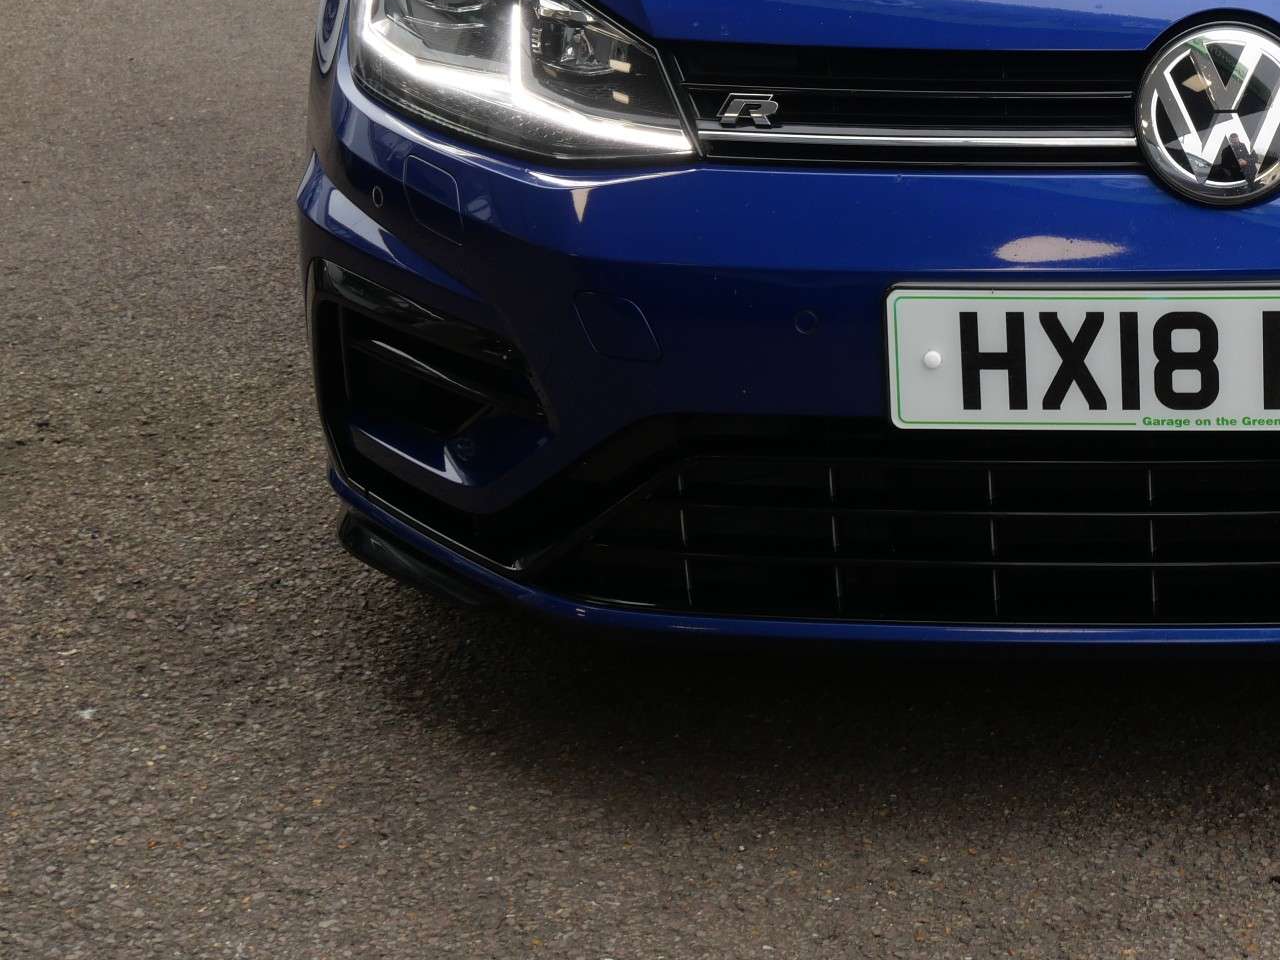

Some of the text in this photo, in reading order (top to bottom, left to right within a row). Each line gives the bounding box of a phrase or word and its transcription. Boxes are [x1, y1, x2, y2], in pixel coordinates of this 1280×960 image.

[716, 92, 779, 127] R
[958, 310, 1221, 411] HX18
[1142, 416, 1190, 428] Garage
[1195, 418, 1211, 426] on
[1216, 416, 1238, 426] the
